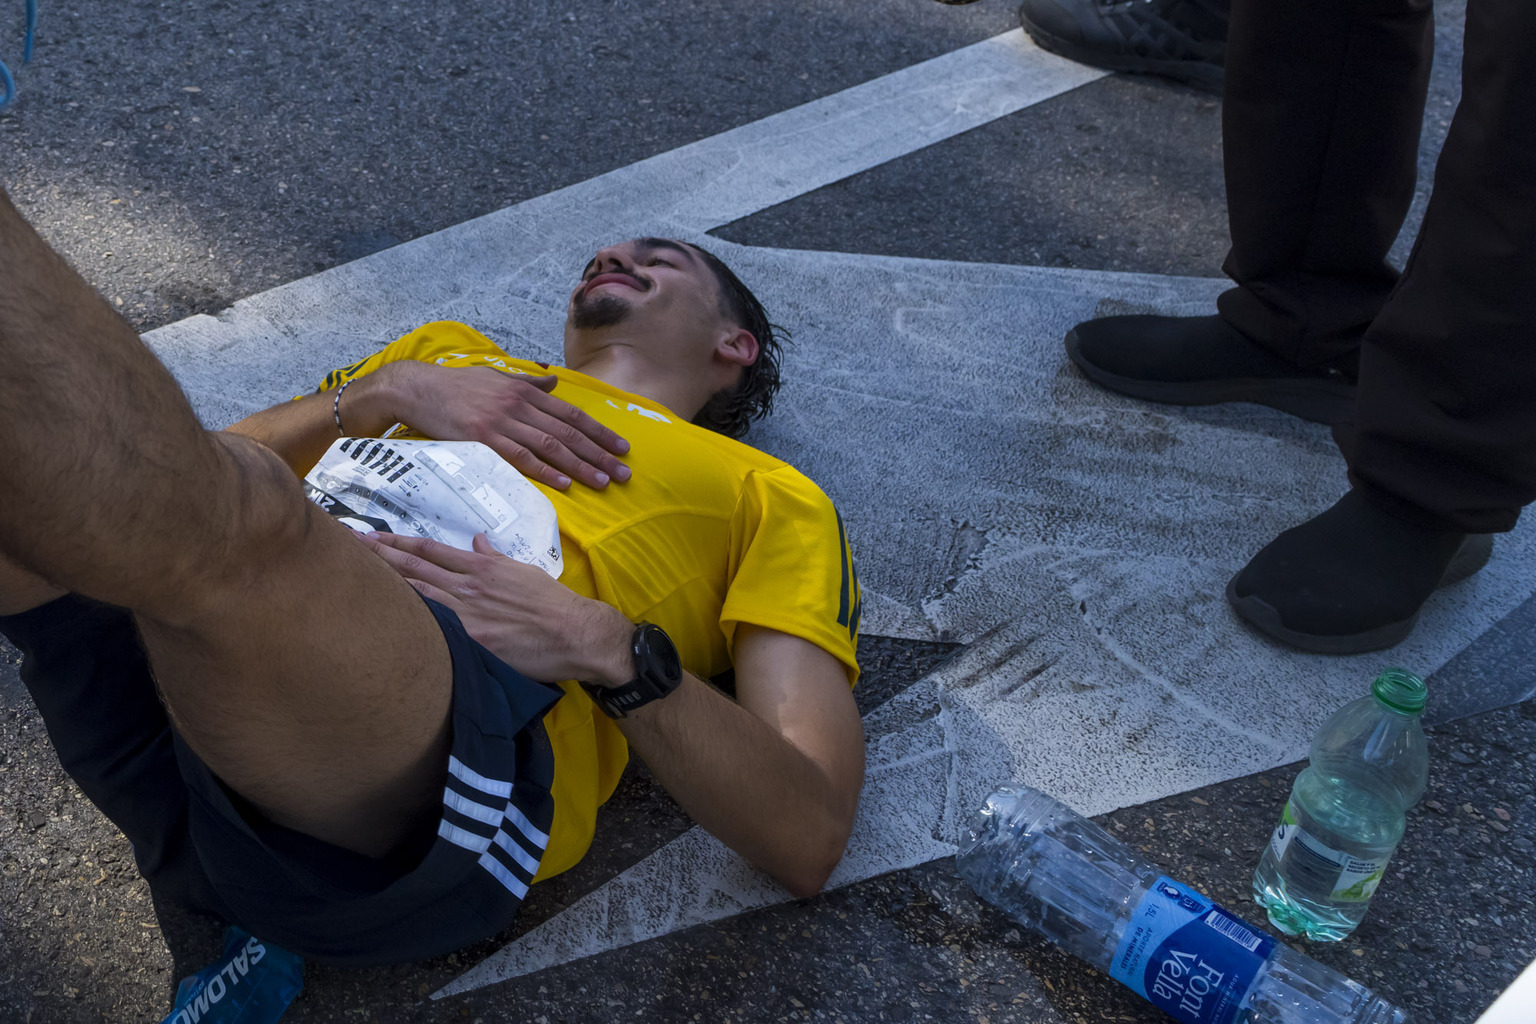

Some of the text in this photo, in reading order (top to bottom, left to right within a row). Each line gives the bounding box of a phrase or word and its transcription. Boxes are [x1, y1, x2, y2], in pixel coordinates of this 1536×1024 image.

[1144, 903, 1160, 918] 1,5L
[1119, 927, 1144, 970] DE MINERALES
[1126, 927, 1154, 976] APORTE NATURAL
[1152, 949, 1198, 1000] Vella
[1179, 959, 1225, 1018] Font
[1229, 973, 1240, 990] AGUA
